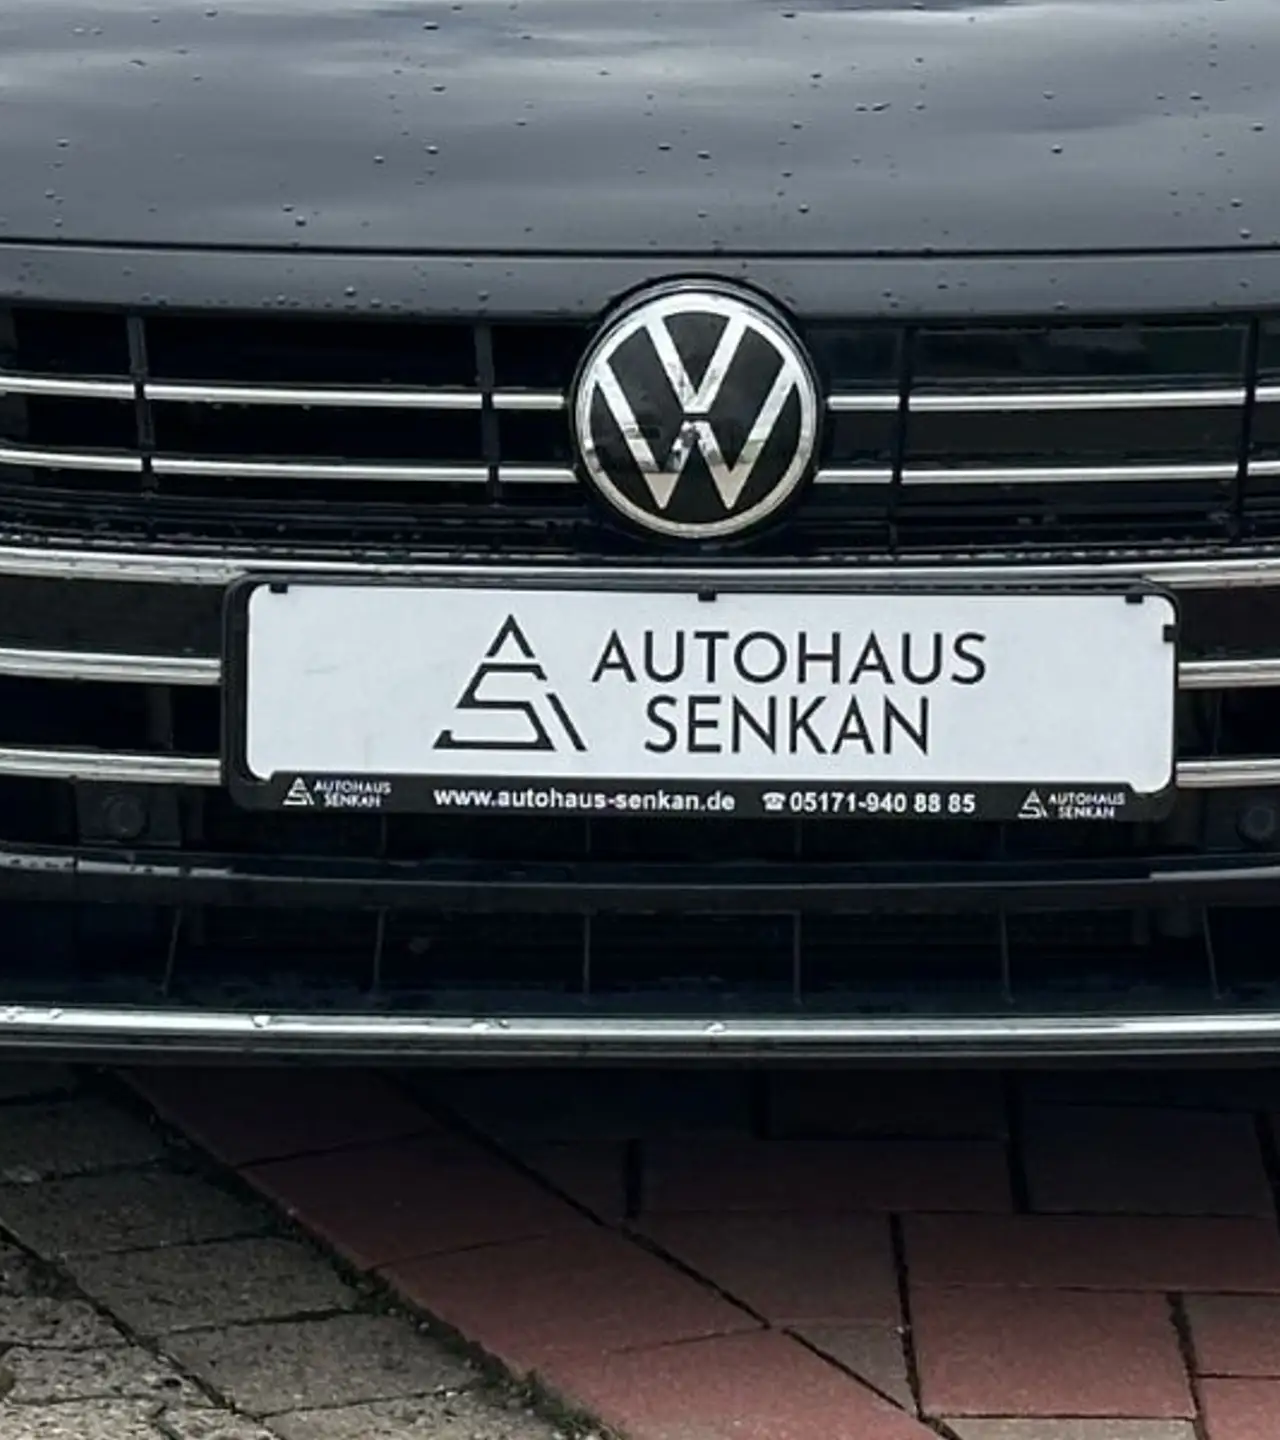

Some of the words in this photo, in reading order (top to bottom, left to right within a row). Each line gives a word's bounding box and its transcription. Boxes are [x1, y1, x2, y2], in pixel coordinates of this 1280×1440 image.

[591, 629, 987, 685] AUTOHAUS
[644, 694, 930, 755] SENKAN
[313, 779, 392, 795] AUTOHAUS
[323, 793, 382, 808] SENKAN
[433, 787, 736, 811] www.autohaus-senkan.de
[789, 791, 908, 813] 05171-940
[914, 792, 941, 813] 88
[947, 793, 976, 814] 85
[1048, 791, 1126, 806] AUTOHAUS
[1057, 806, 1116, 820] SENKAN
